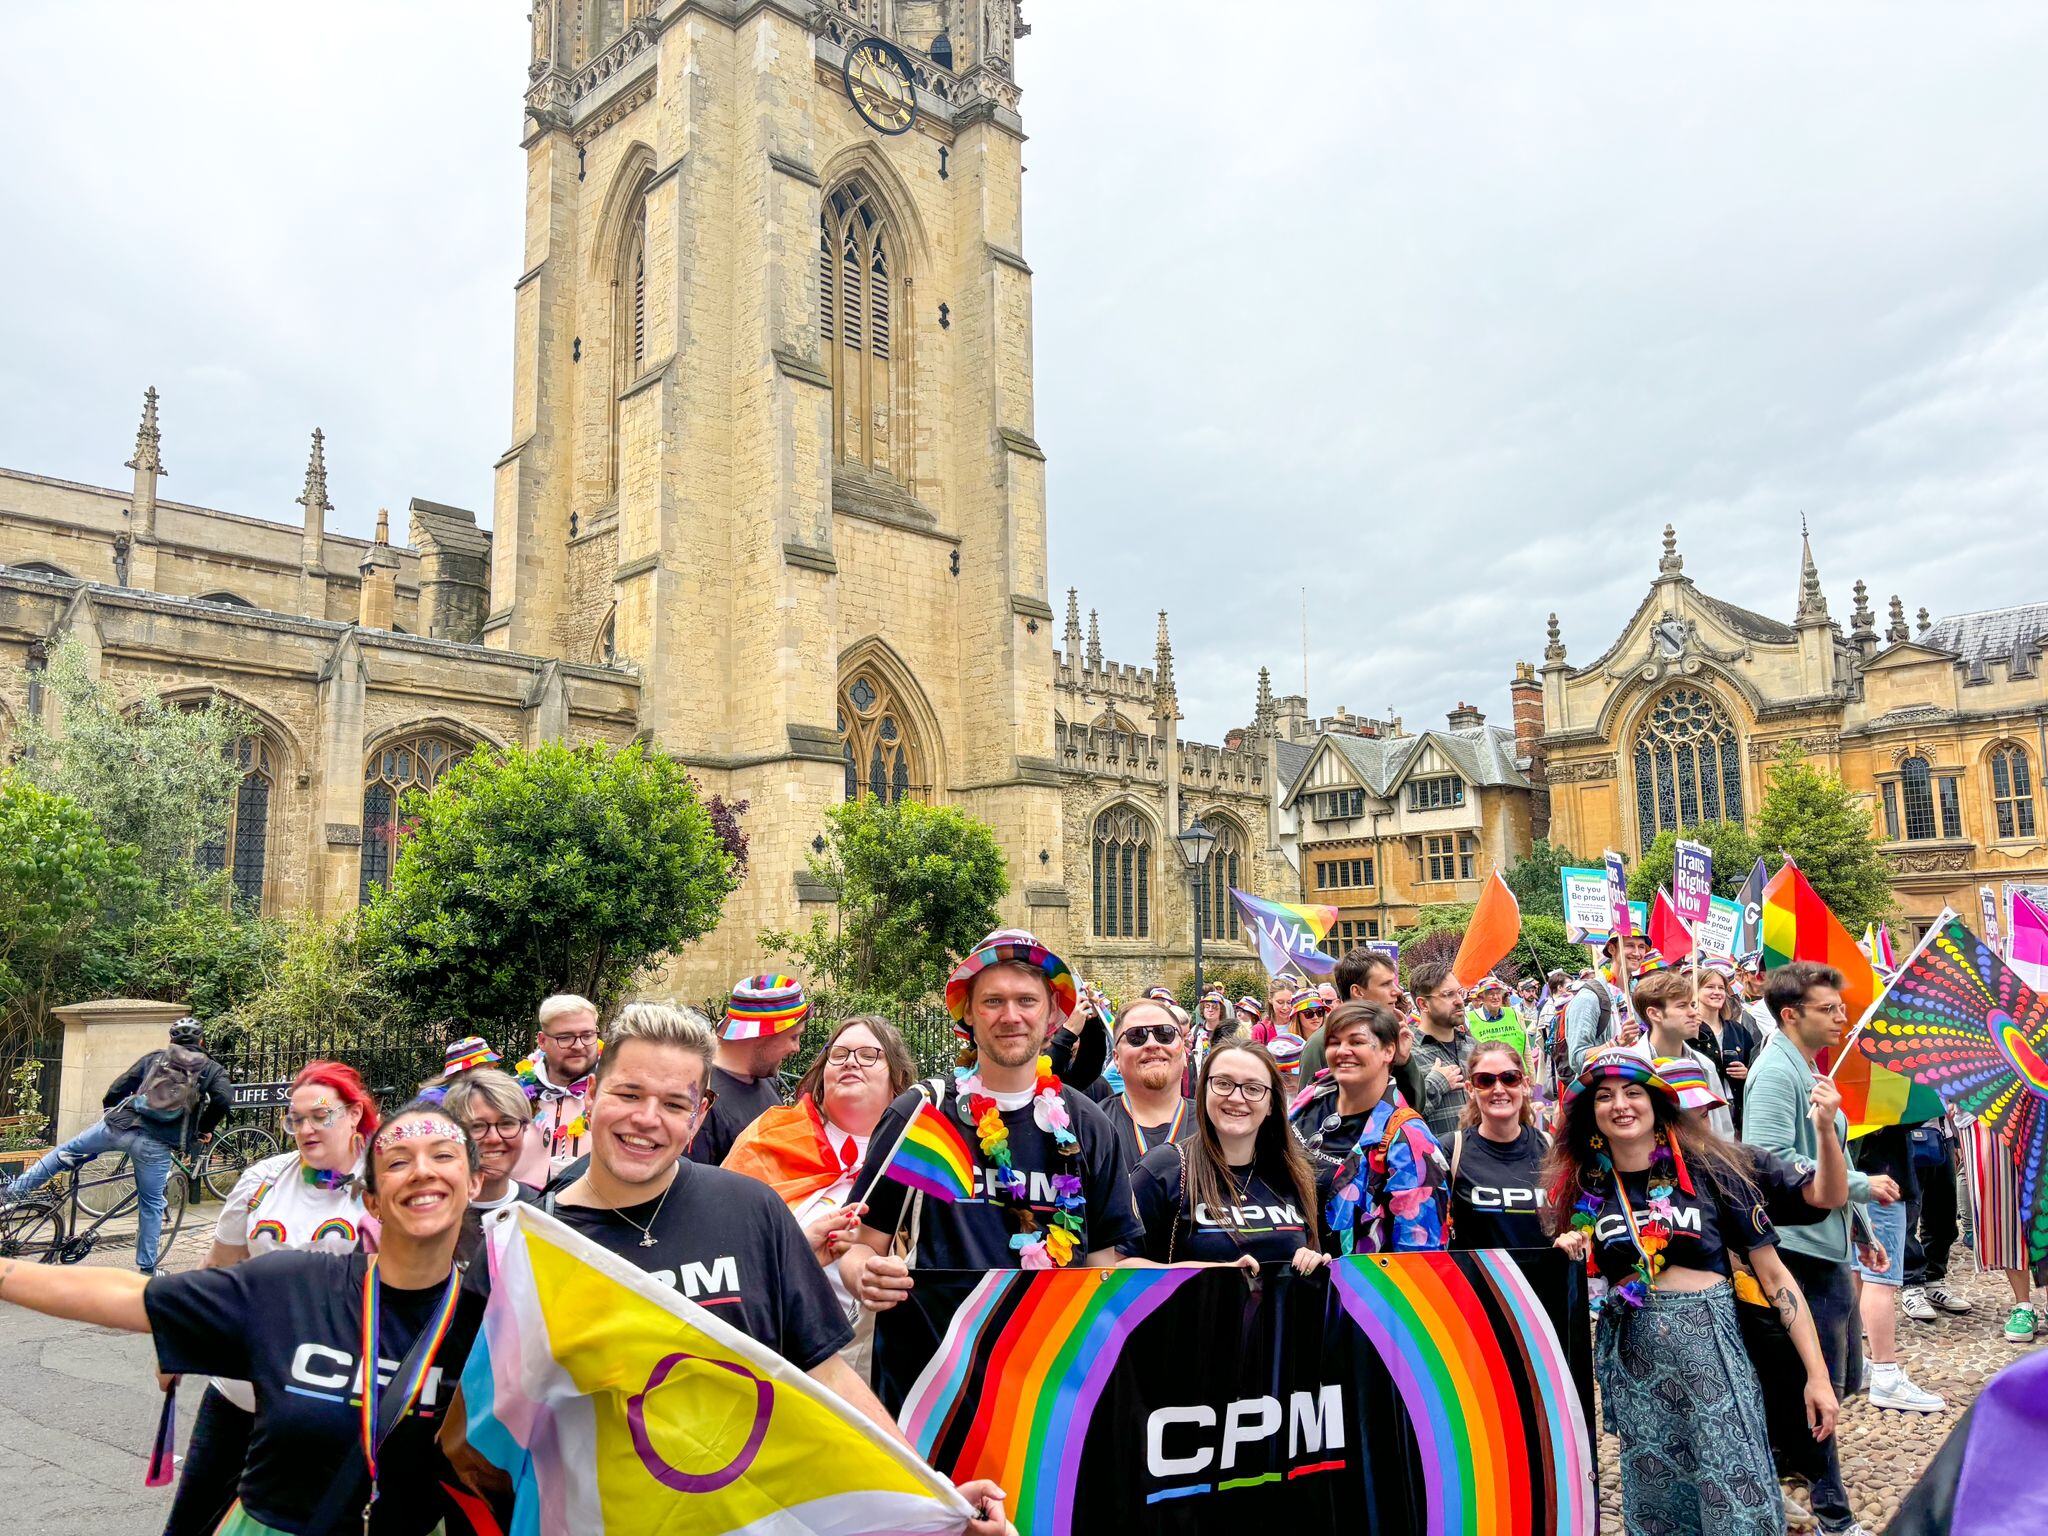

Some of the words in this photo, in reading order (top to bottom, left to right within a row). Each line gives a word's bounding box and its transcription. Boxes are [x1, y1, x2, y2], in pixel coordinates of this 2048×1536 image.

[1677, 848, 1705, 874] Trans
[1575, 884, 1585, 892] Be
[1586, 886, 1601, 894] you
[1678, 868, 1710, 896] Rights
[1571, 892, 1582, 900] Be
[1583, 894, 1606, 902] proud
[1677, 889, 1702, 913] Now
[1577, 913, 1590, 922] 116
[1591, 914, 1604, 923] 123
[1717, 914, 1731, 923] you
[1711, 921, 1733, 933] proud
[1701, 937, 1712, 947] 116
[1713, 940, 1725, 951] 123
[234, 1088, 269, 1103] LIFFE
[1195, 1202, 1305, 1226] CPM
[648, 1256, 741, 1298] PM
[1147, 1384, 1346, 1478] CPM
